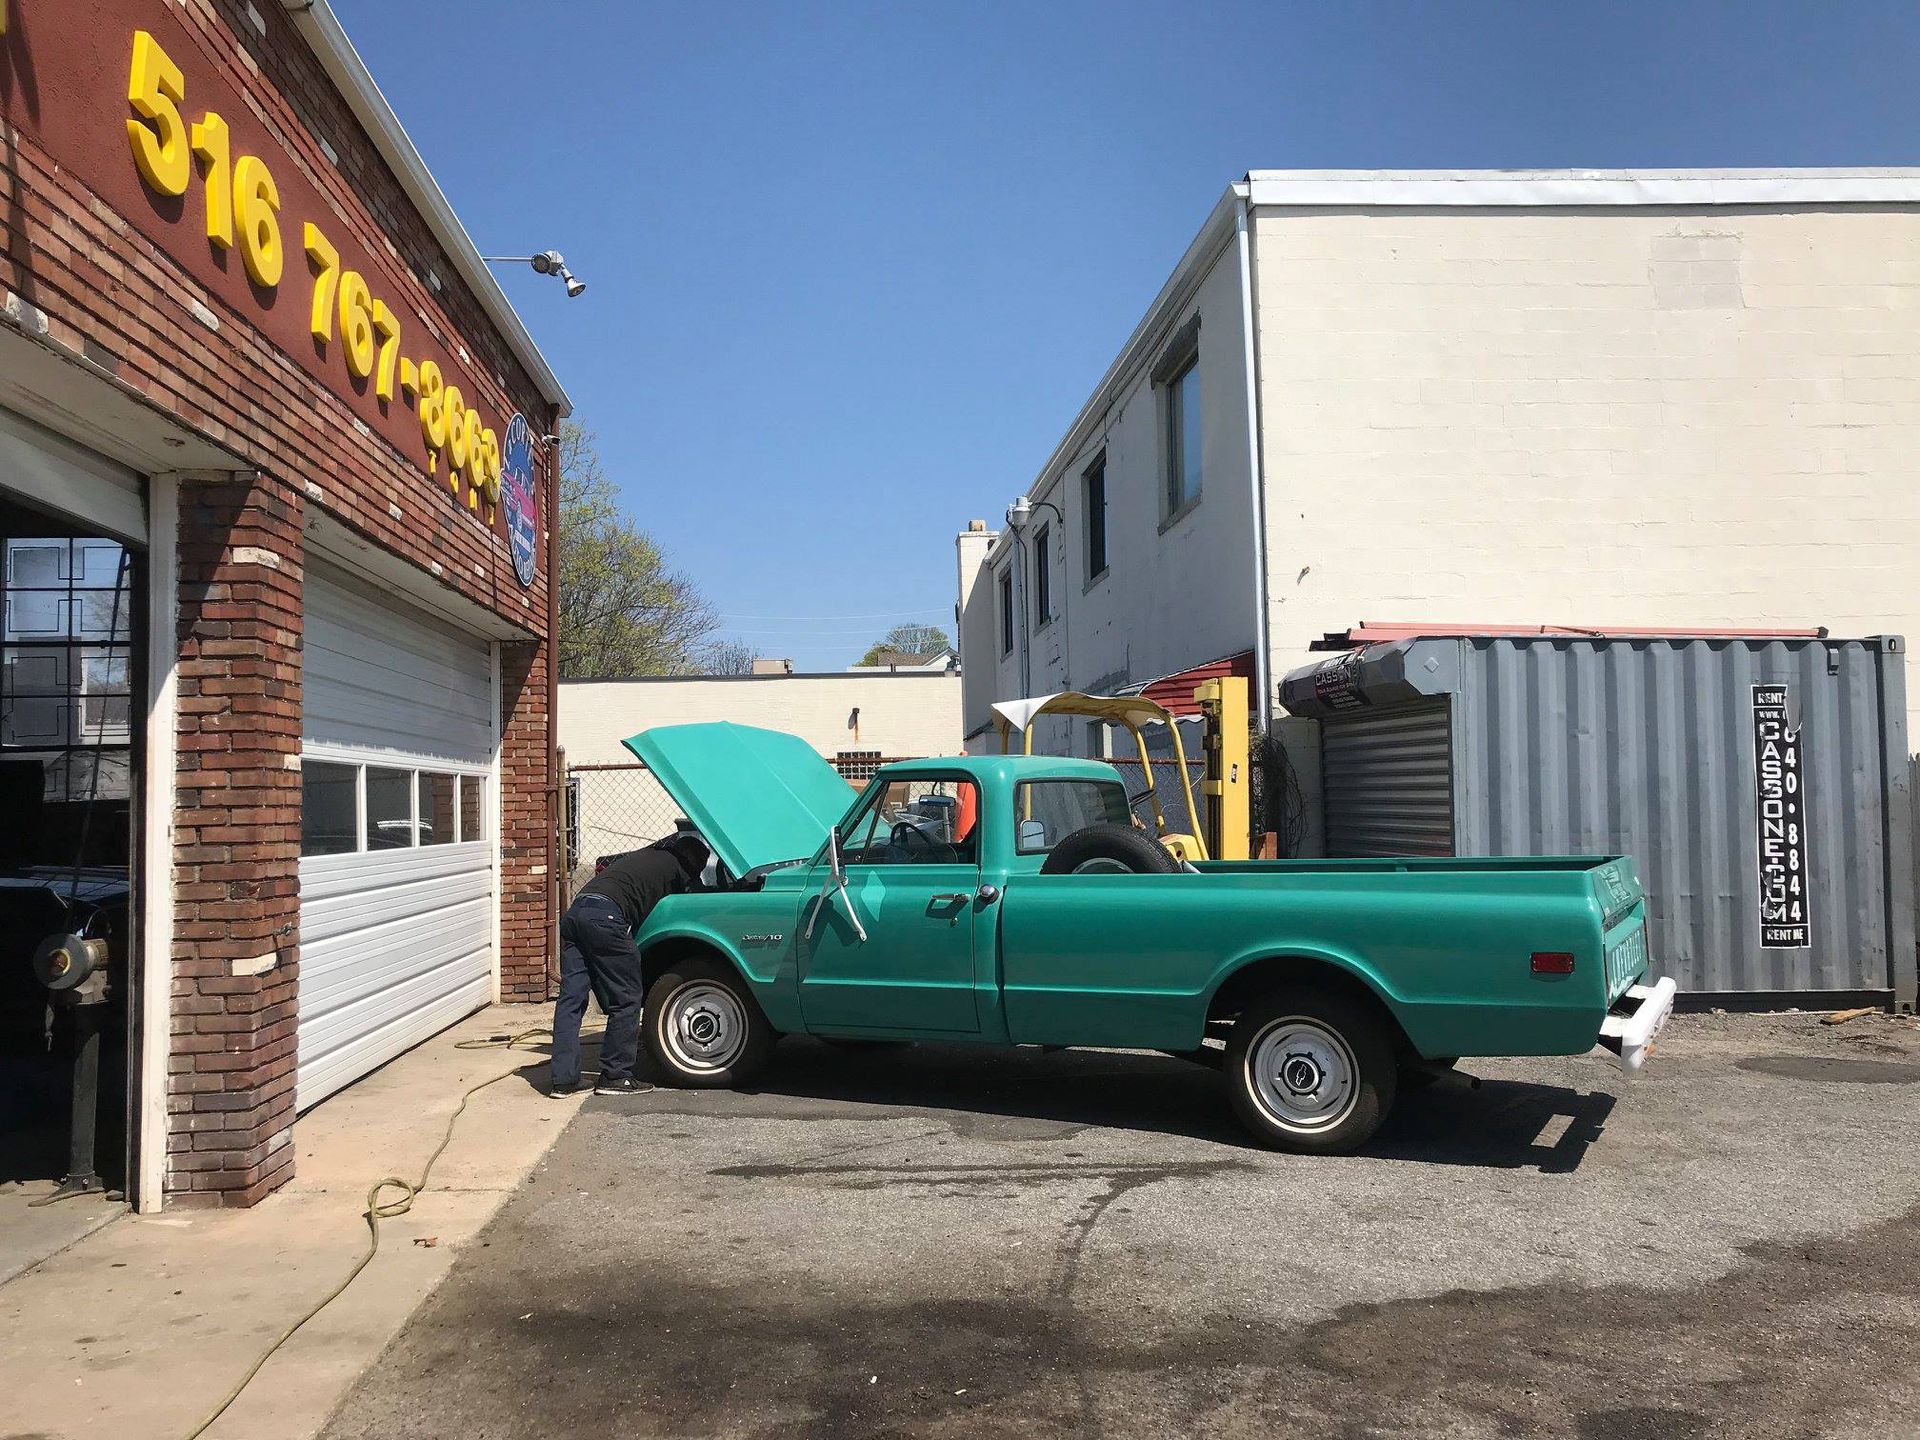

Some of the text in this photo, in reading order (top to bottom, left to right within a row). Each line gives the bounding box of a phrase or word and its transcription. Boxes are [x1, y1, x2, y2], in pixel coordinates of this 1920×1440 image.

[126, 30, 500, 503] 516 767-8669
[1757, 692, 1783, 704] RENT
[1766, 928, 1804, 941] RENT ME
